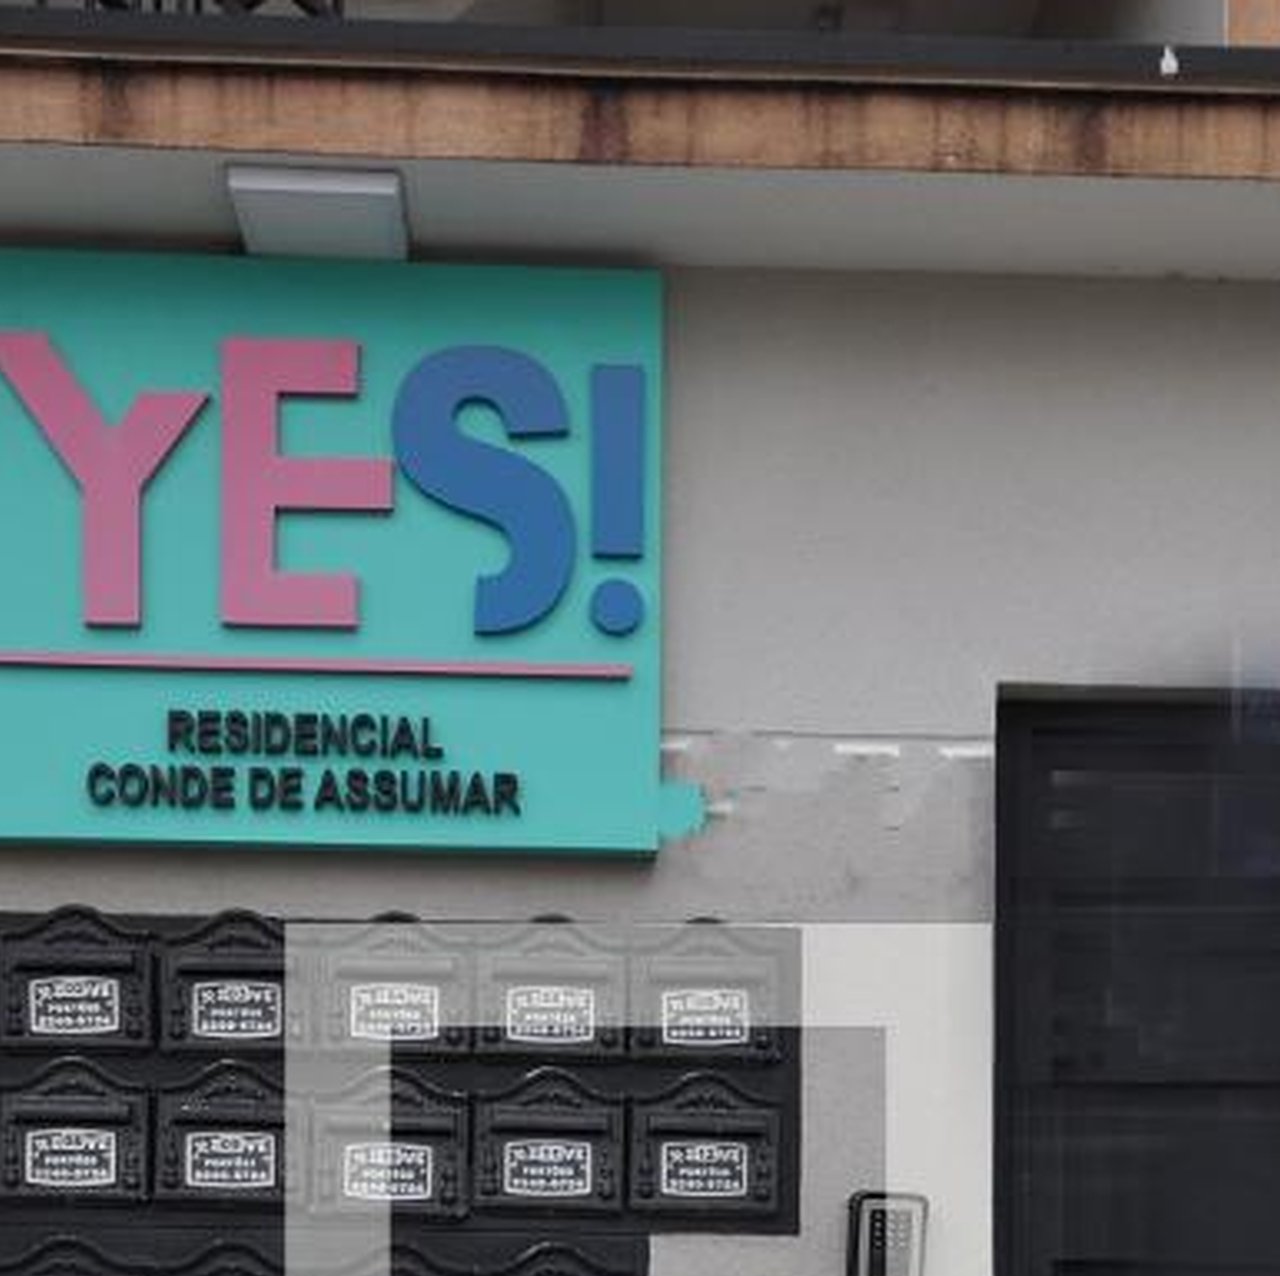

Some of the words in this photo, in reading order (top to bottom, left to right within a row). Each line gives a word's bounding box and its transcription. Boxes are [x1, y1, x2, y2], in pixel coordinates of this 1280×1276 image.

[166, 709, 446, 760] RESIDENCIAL
[86, 762, 236, 811] CONDE
[248, 768, 305, 812] DE
[314, 769, 523, 817] ASSUMAR
